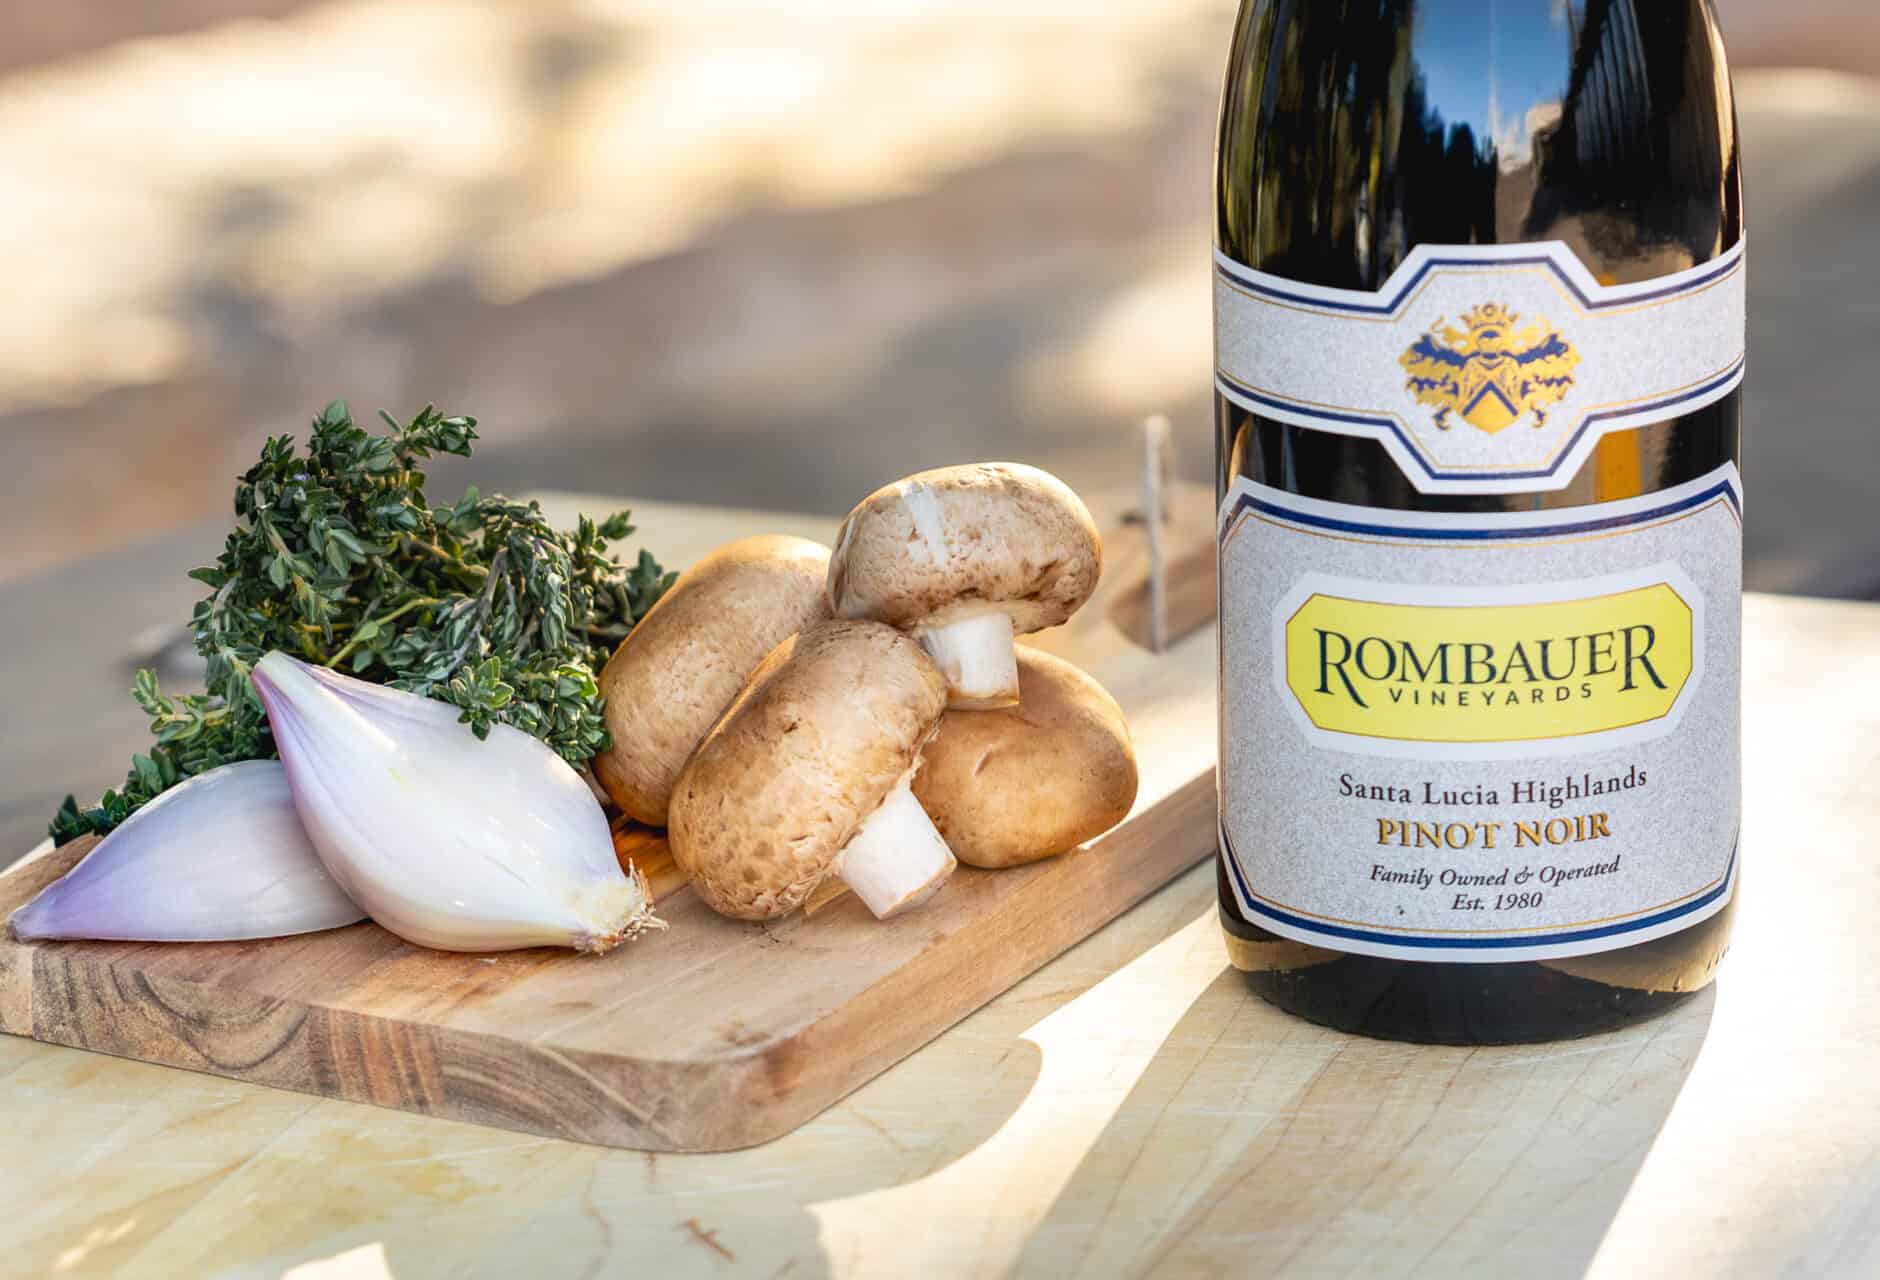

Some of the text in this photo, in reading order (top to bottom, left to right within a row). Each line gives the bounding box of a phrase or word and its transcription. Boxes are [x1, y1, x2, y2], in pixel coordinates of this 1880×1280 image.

[1313, 623, 1669, 709] ROMBAUER
[1387, 682, 1593, 707] VINEYARDS
[1339, 764, 1648, 809] Santa Lucia Highlands
[1376, 811, 1613, 849] PINOT NOIR
[1369, 854, 1621, 890] Family Owned & Operated
[1450, 891, 1544, 912] Est. 1980
